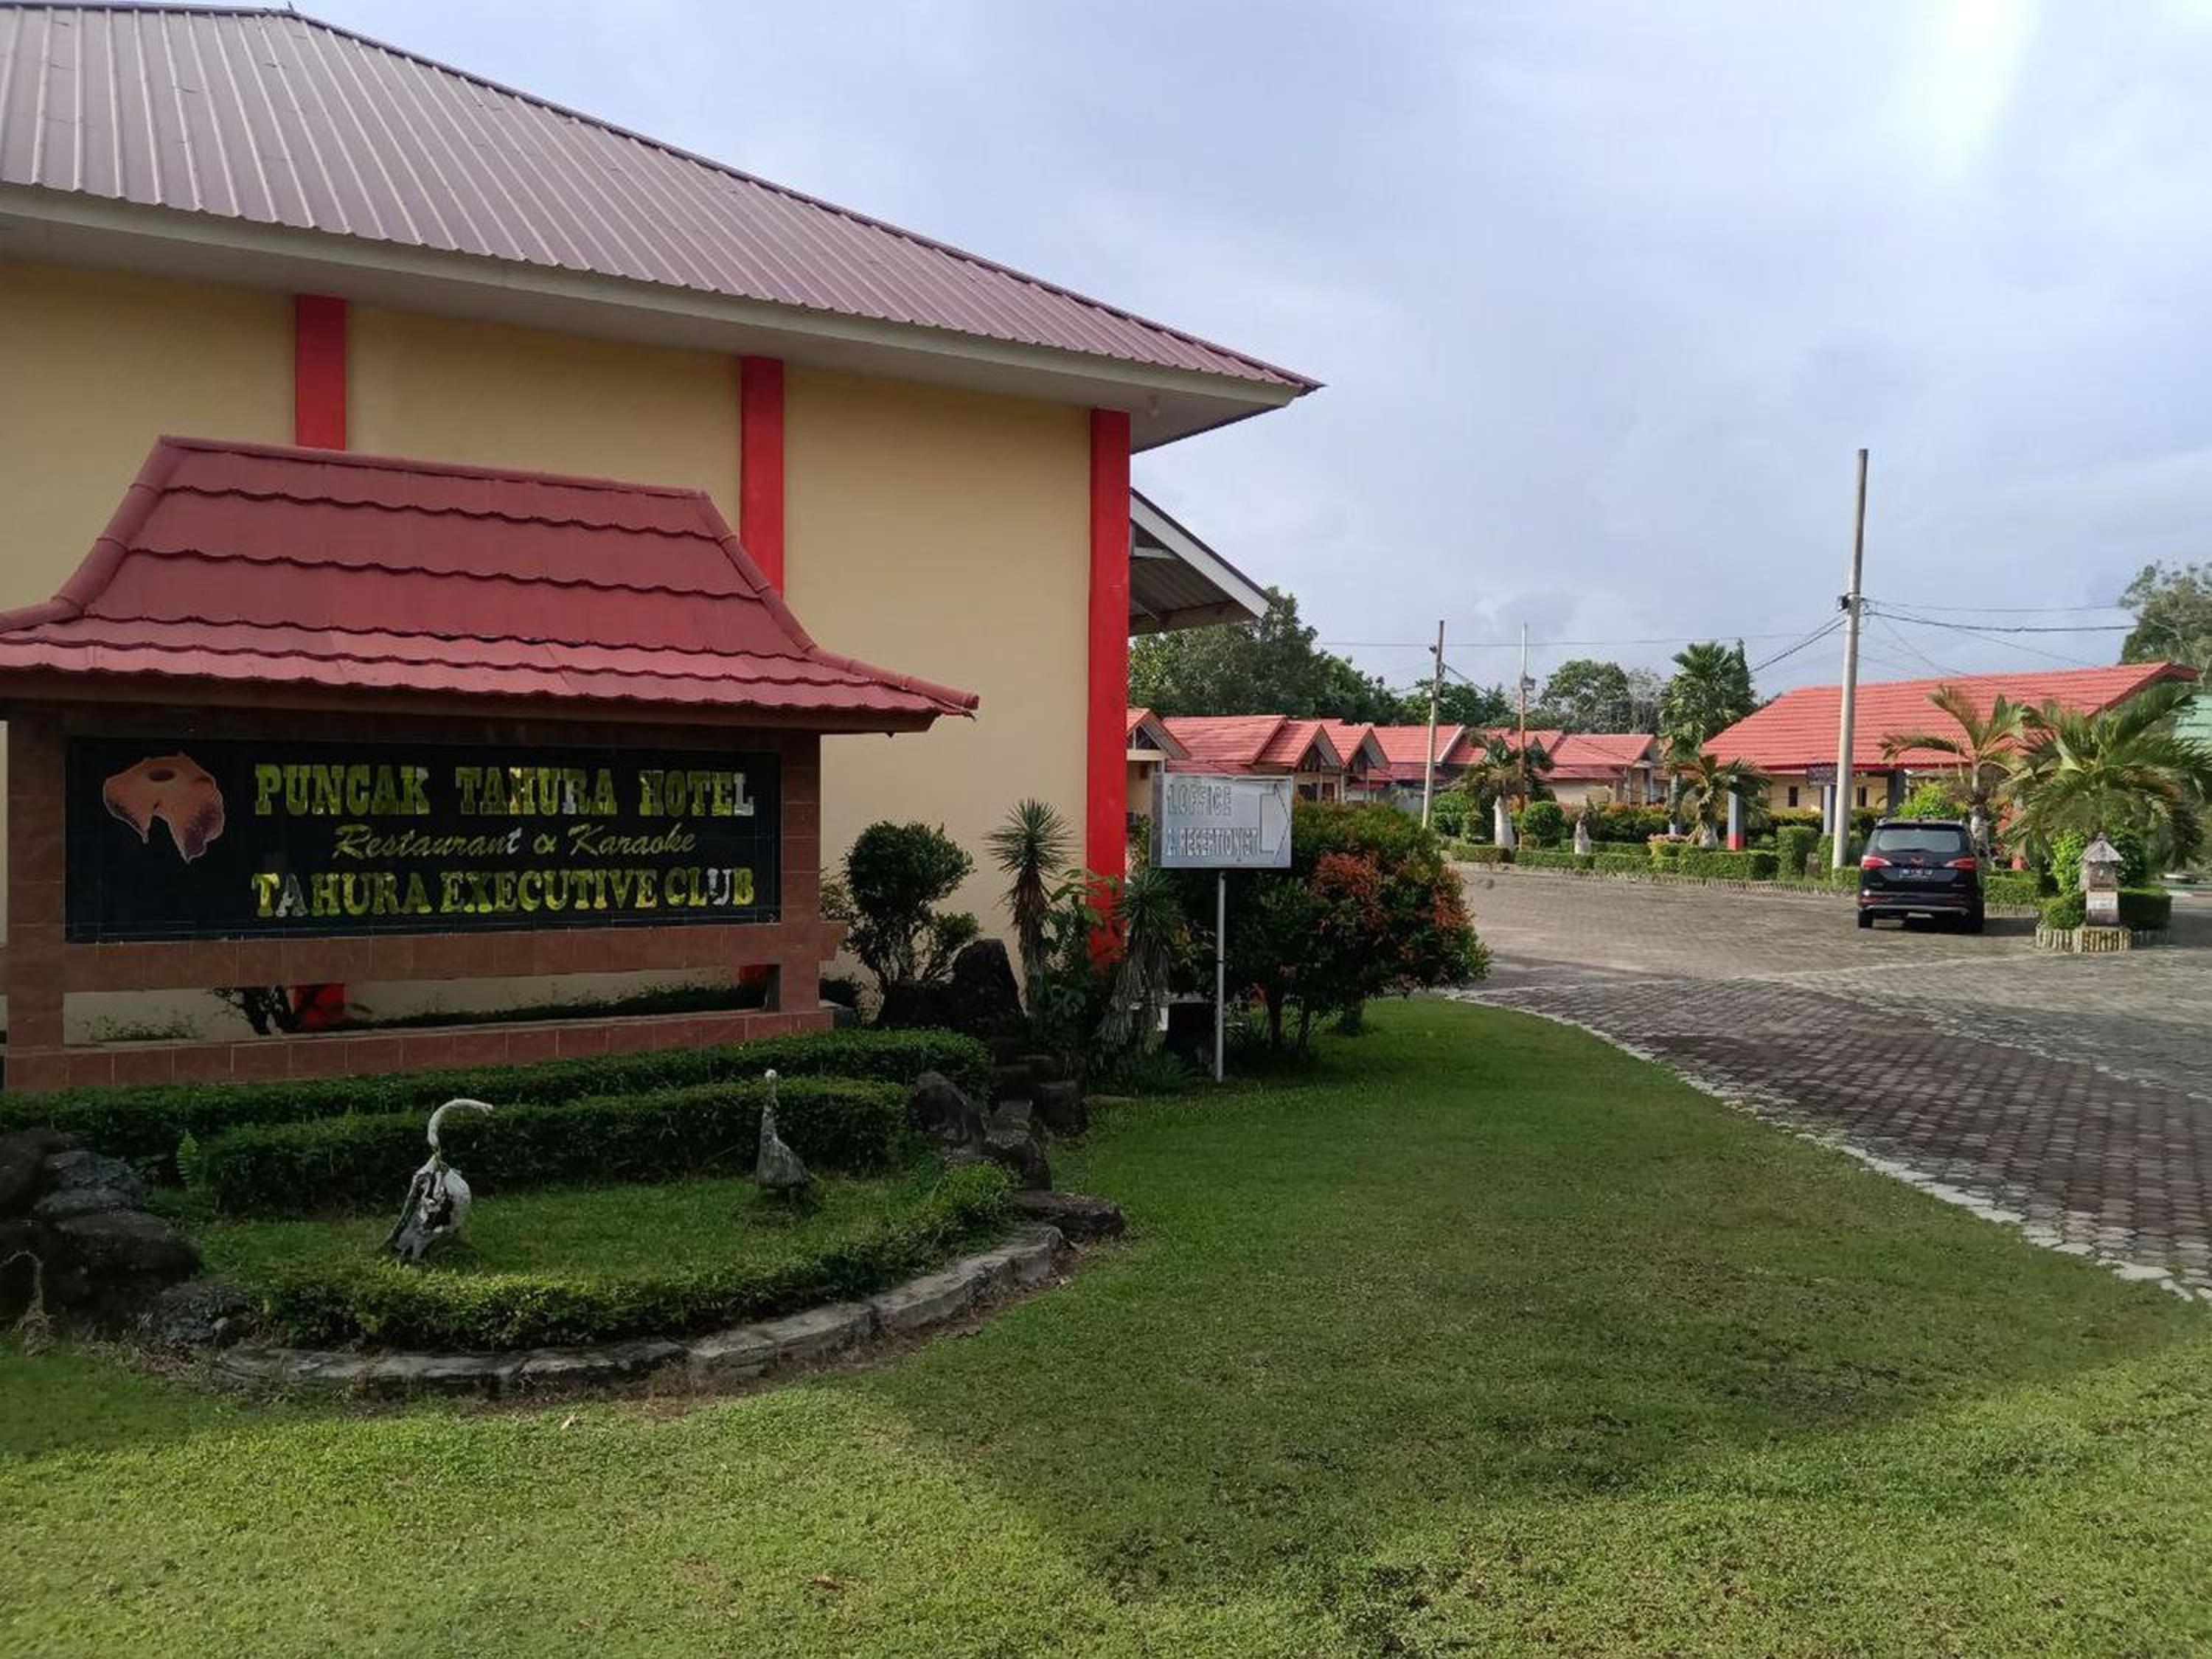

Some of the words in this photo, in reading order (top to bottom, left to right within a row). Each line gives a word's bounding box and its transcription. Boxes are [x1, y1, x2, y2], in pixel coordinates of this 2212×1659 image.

[254, 763, 431, 816] PUNCAK
[455, 766, 618, 816] TAHURA
[639, 769, 755, 817] HOTEL
[331, 824, 524, 860] Restaurant
[567, 822, 697, 858] Karaoke
[250, 872, 433, 919] TAHURA
[439, 869, 658, 914] EXECUTIVE
[664, 866, 756, 908] CLUB
